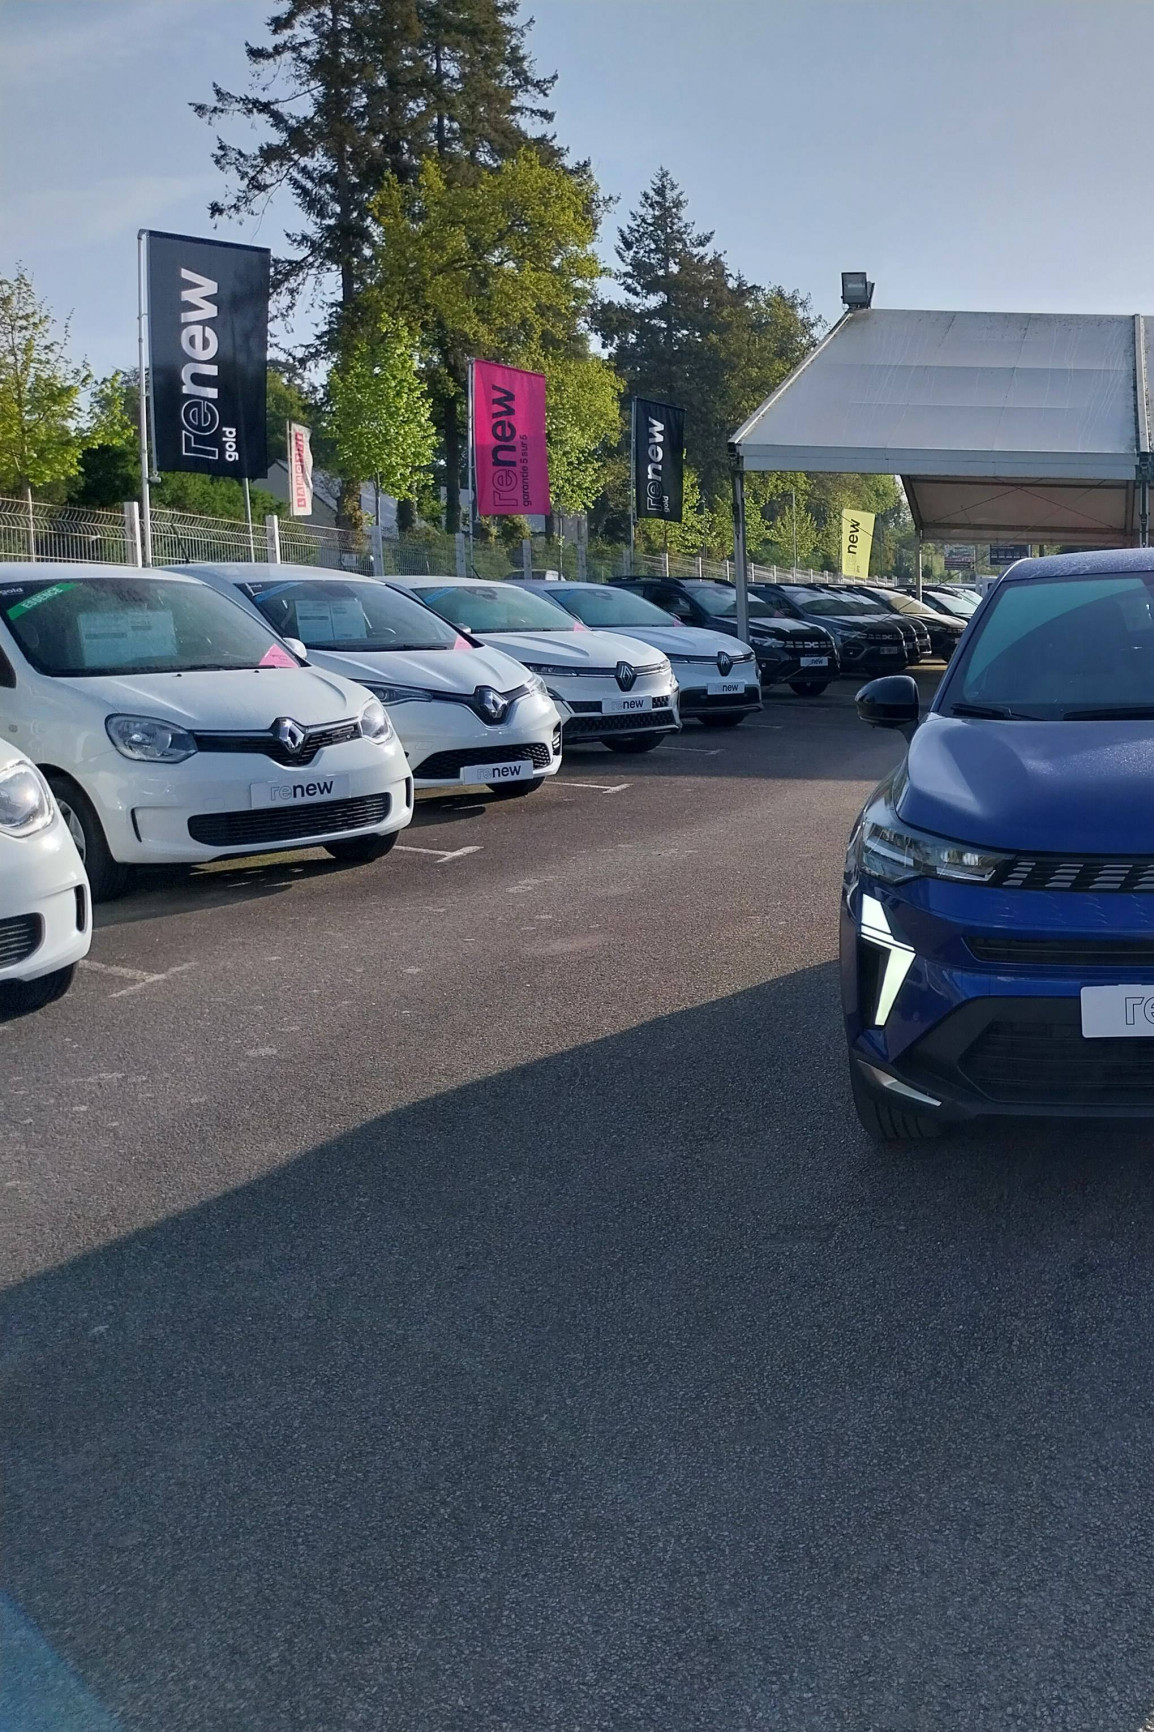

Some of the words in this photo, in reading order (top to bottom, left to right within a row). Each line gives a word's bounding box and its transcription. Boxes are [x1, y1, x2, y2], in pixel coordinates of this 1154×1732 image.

[180, 267, 219, 460] renew
[222, 427, 239, 462] gold
[492, 384, 518, 507] renew
[647, 416, 665, 511] renew
[520, 465, 532, 507] garantie
[662, 495, 670, 512] gold
[270, 780, 334, 801] renew
